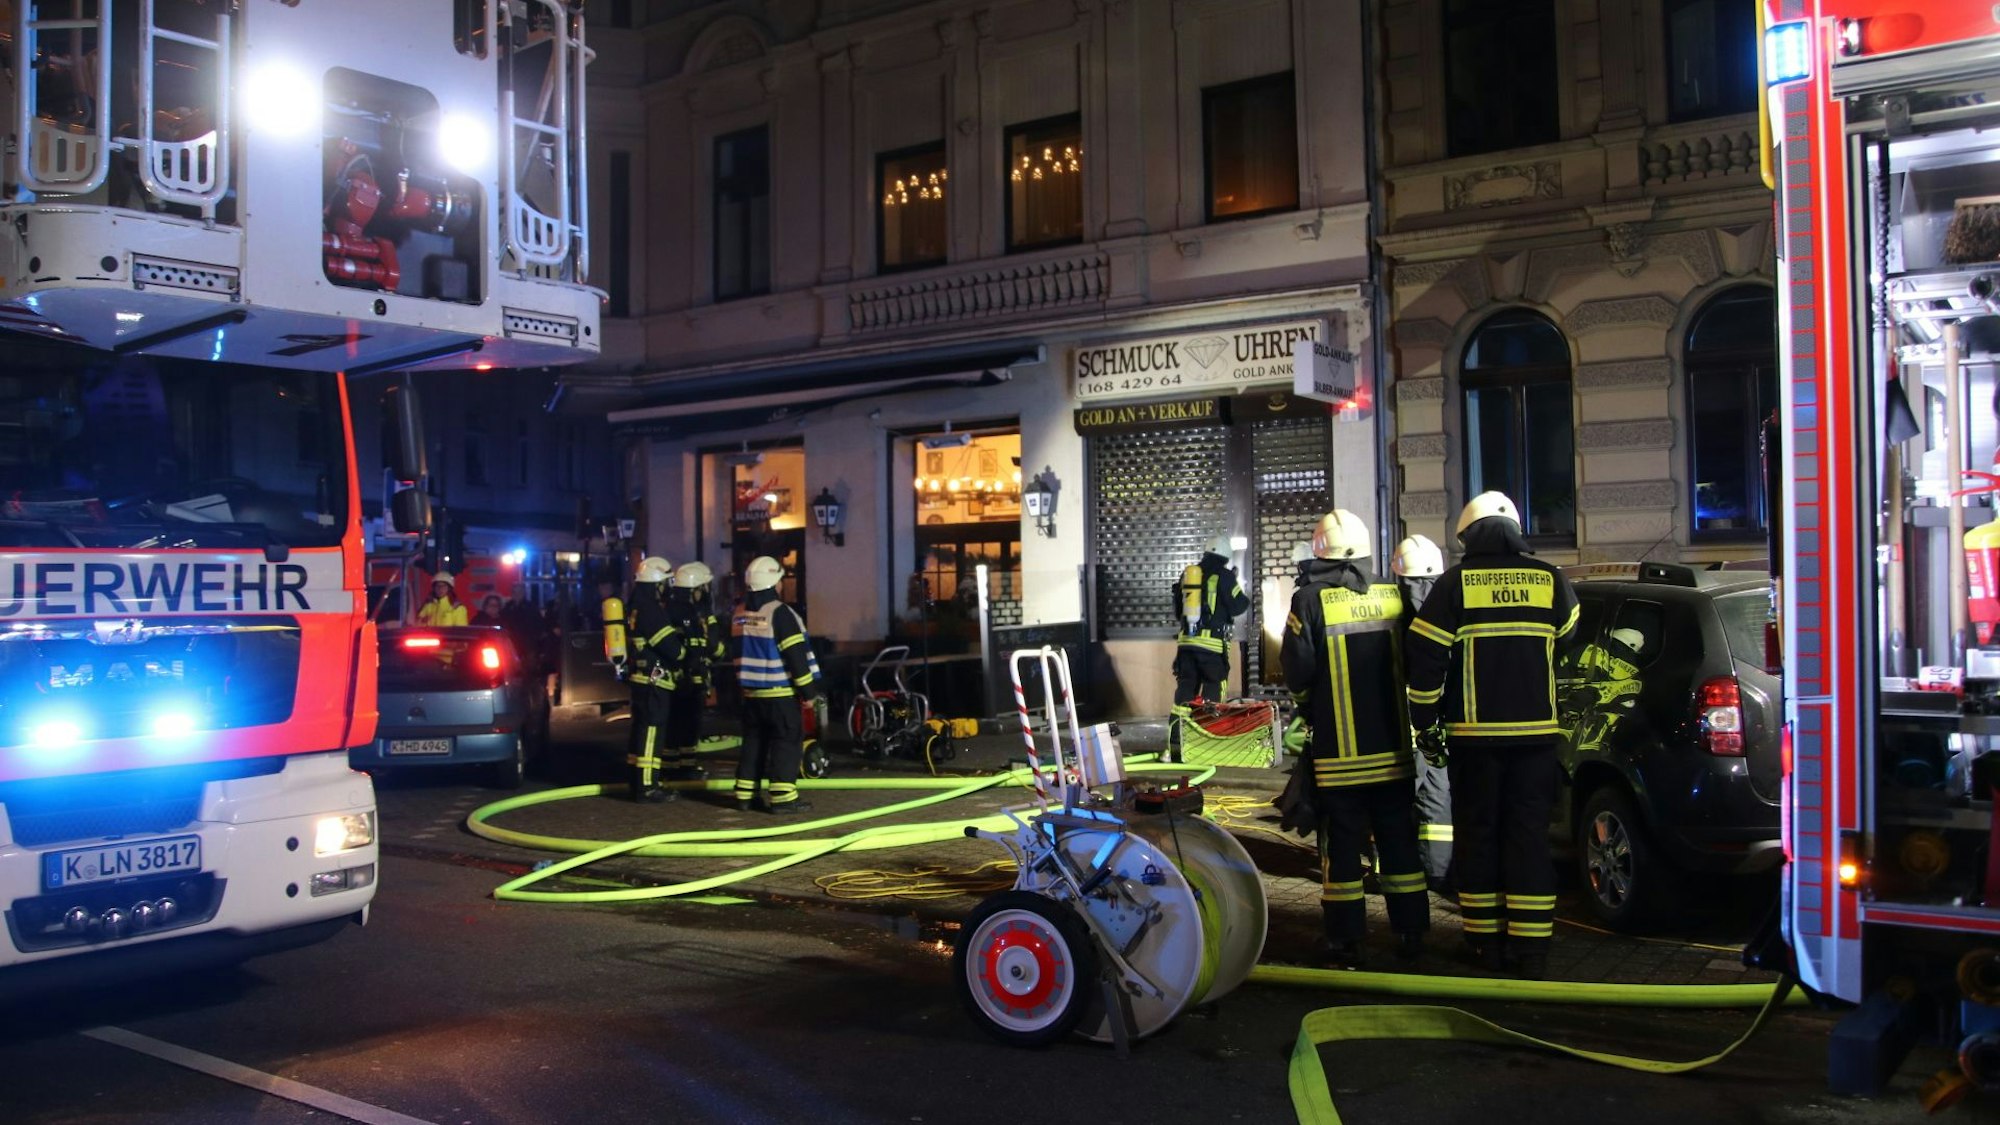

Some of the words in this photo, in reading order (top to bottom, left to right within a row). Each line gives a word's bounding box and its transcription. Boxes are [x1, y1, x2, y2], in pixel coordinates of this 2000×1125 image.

[1079, 342, 1180, 378] SCHMUCK
[1233, 366, 1265, 379] GOLD
[1269, 363, 1294, 376] ANK
[1121, 376, 1153, 389] 429
[1160, 374, 1182, 386] 64
[1080, 409, 1115, 426] GOLD
[1117, 407, 1136, 424] AN
[1149, 400, 1214, 420] VERKAUF
[1590, 564, 1638, 574] DUSTER
[1464, 572, 1551, 587] BERUFSFEUERWEHR
[0, 562, 311, 617] UERWEHR
[1492, 586, 1529, 604] KÖLN
[1351, 601, 1383, 619] KÖLN
[50, 660, 184, 689] MAN
[392, 742, 400, 753] K
[405, 742, 419, 752] HD
[422, 741, 448, 752] 4945
[66, 855, 82, 880] K
[100, 849, 132, 876] LN
[137, 842, 196, 871] 3817
